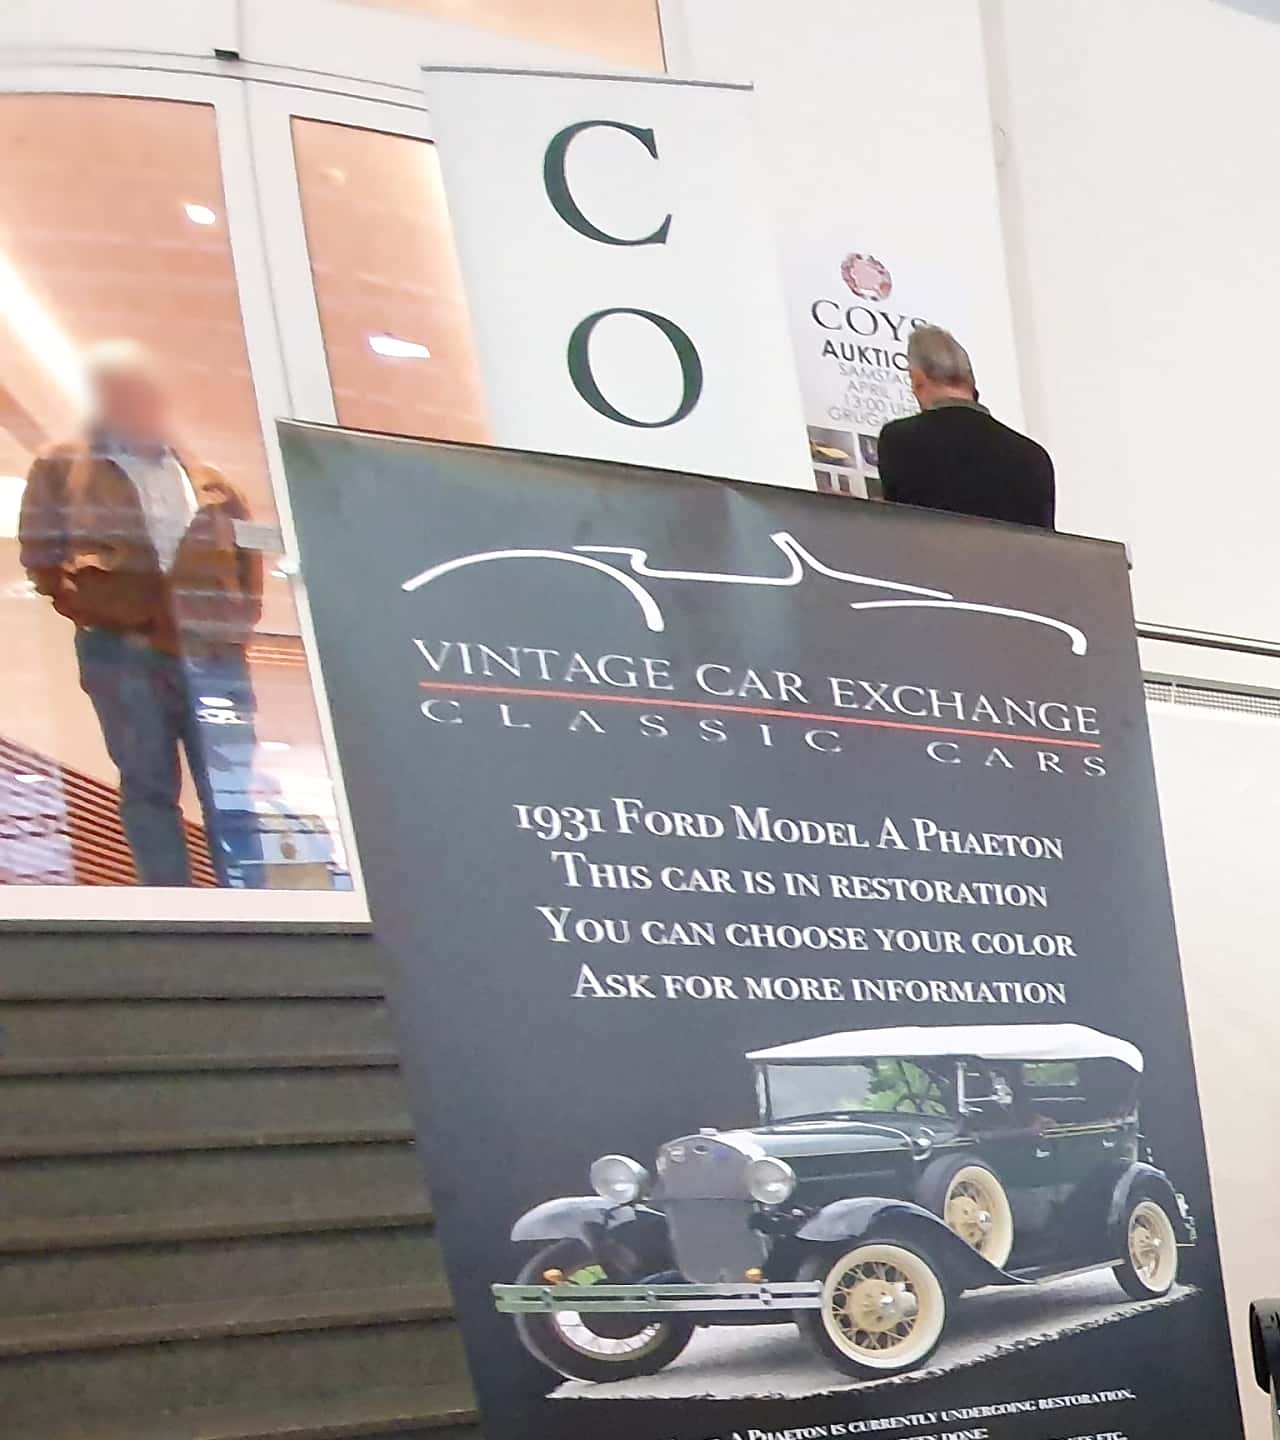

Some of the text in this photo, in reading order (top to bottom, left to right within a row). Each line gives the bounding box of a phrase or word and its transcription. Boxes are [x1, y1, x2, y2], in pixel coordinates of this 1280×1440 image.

[821, 339, 911, 371] AUKTIO
[412, 638, 1101, 735] VINTAGE CAR EXCHANGE
[420, 699, 1107, 777] CLASSIC CARS
[512, 798, 1064, 860] 1931 FORD MODEL A PHAETON
[550, 850, 1048, 907] THIS CAR IS IN RESTORATION
[534, 906, 1077, 956] YOU CAN CHOOSE YOUR COLOR
[570, 964, 1066, 1004] ASK FOR MORE INFORMATION
[830, 1424, 848, 1435] IS
[848, 1412, 938, 1433] CURRENTLY
[941, 1399, 1037, 1421] UNDERGOING
